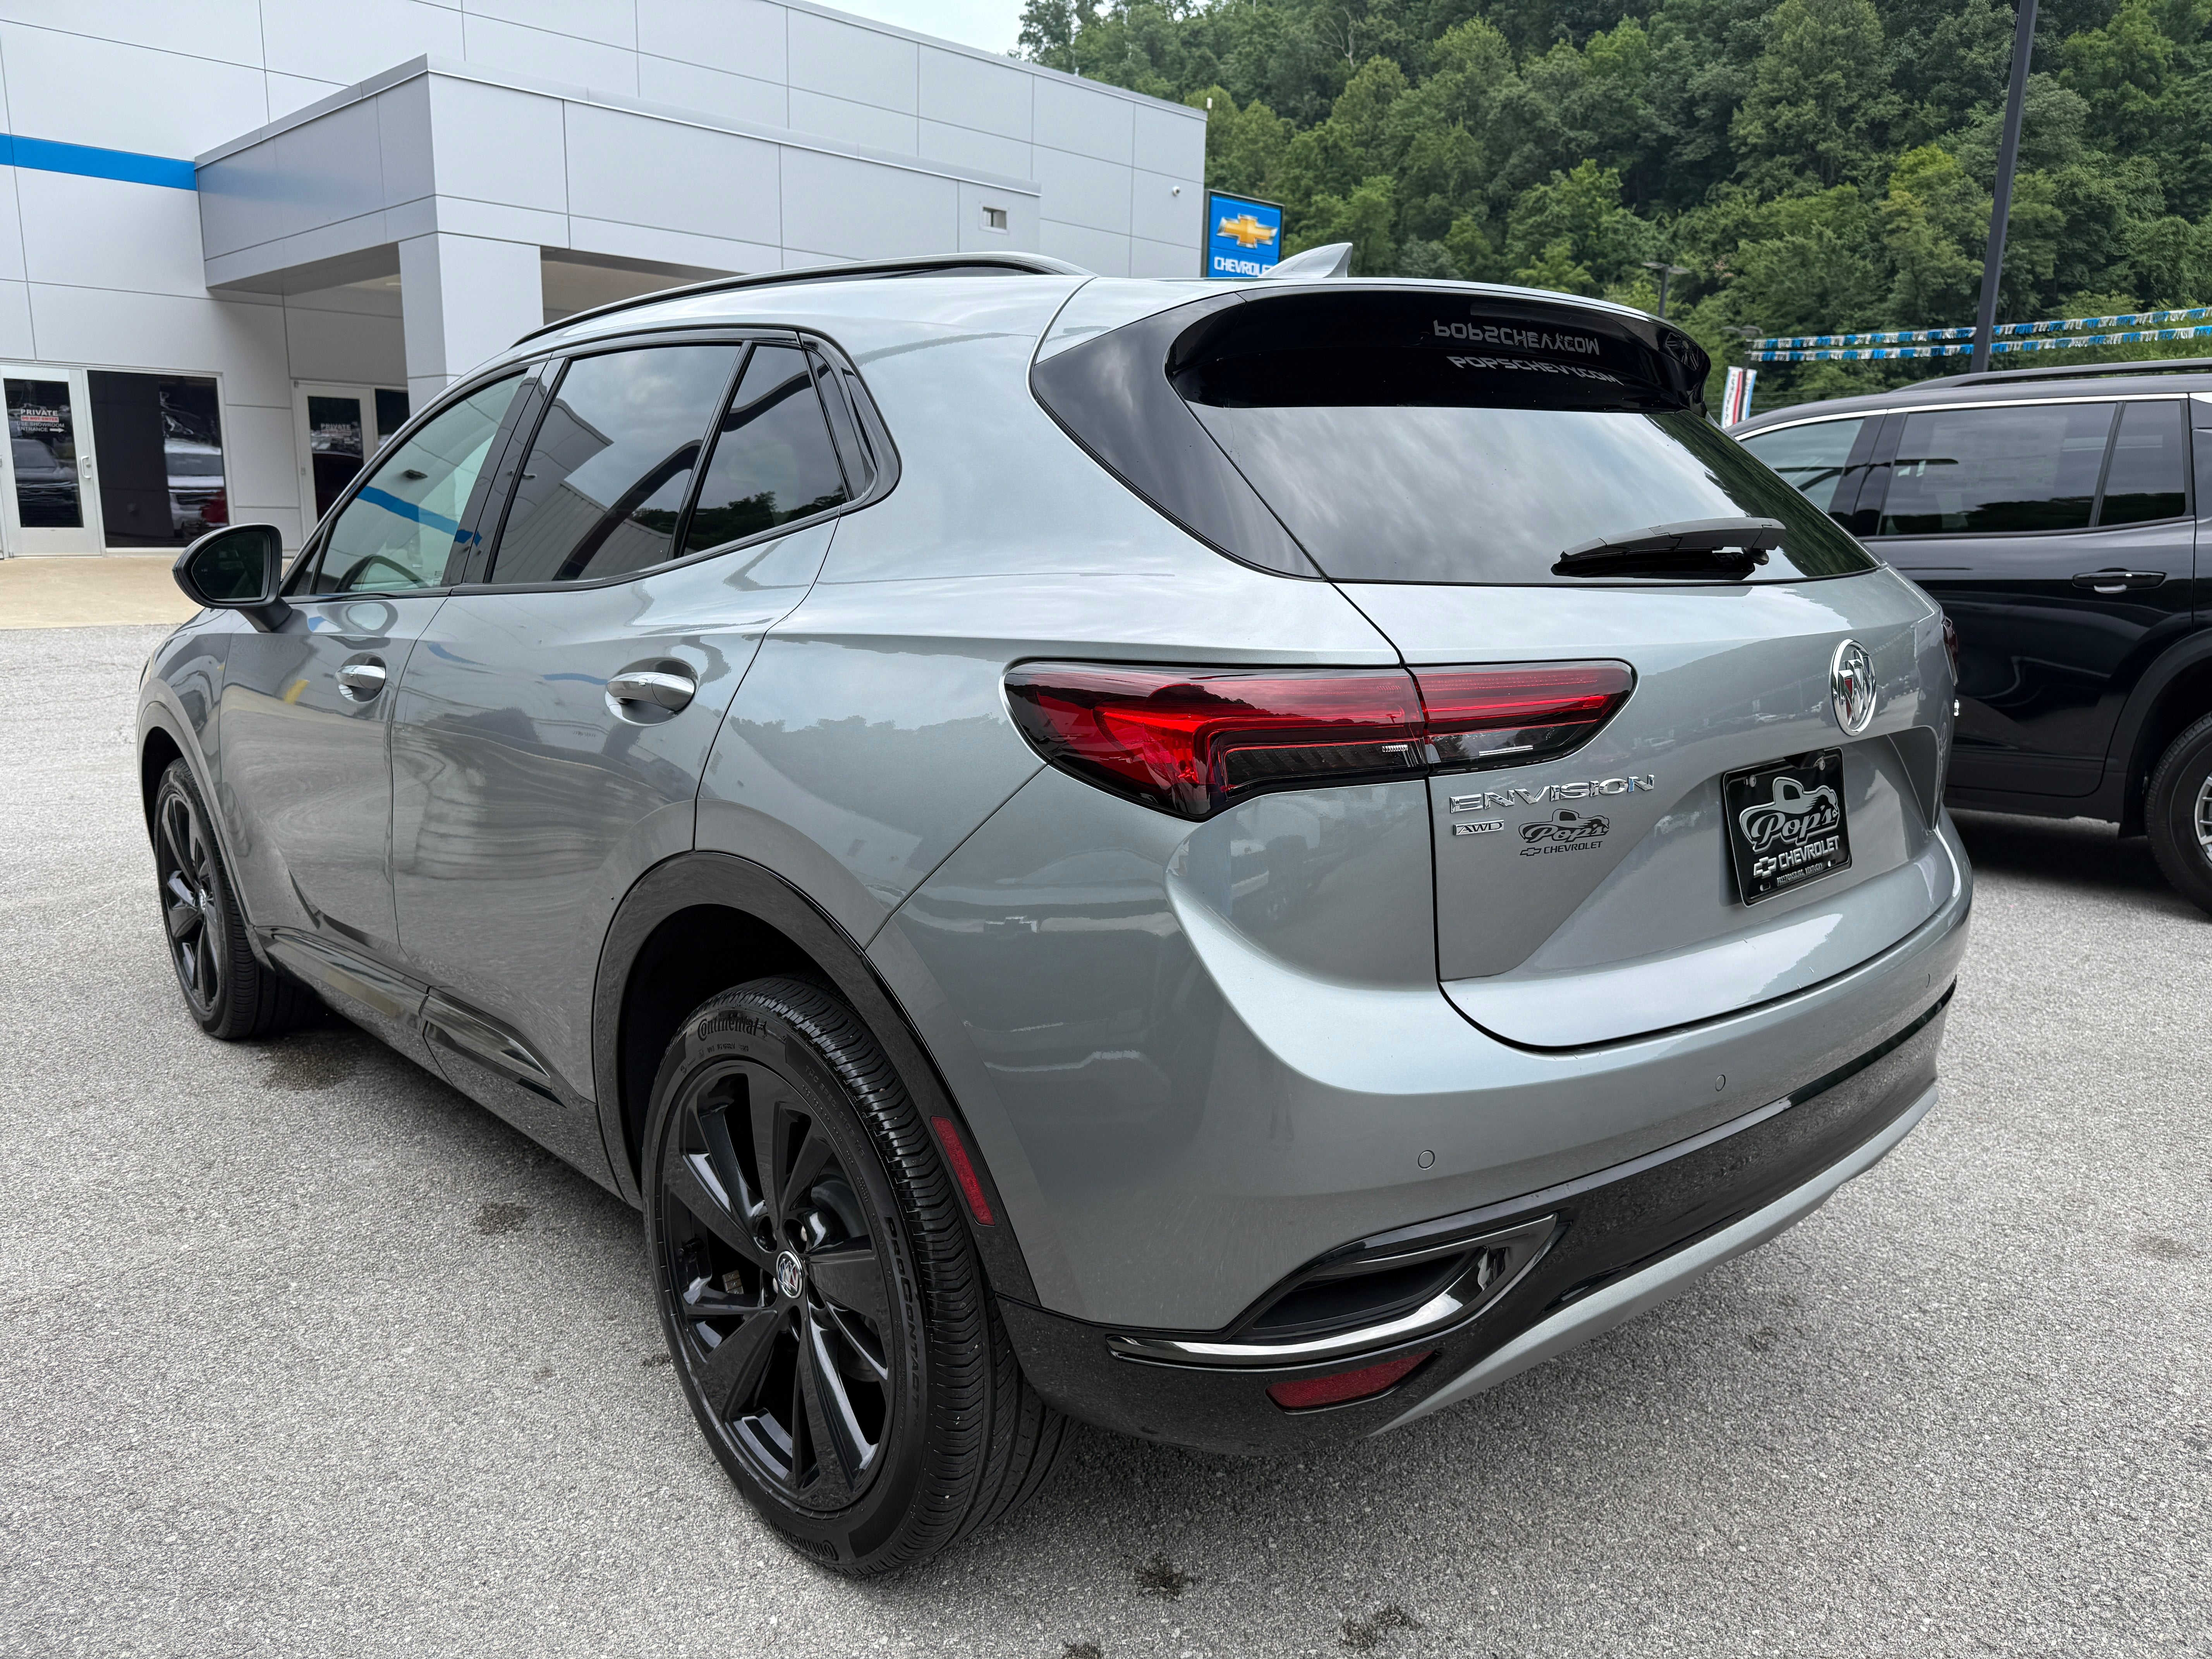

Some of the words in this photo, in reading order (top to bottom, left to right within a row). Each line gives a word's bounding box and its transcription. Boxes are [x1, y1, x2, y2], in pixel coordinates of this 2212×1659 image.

[1214, 256, 1274, 276] CHEVROLE
[1446, 356, 1624, 386] POPSCHEVY.COM
[1449, 775, 1654, 813] ENVISION
[1458, 822, 1503, 834] AWD
[1544, 841, 1603, 854] CHEVROLET
[1778, 835, 1839, 871] CHEVROLET
[697, 1015, 760, 1041] Continental
